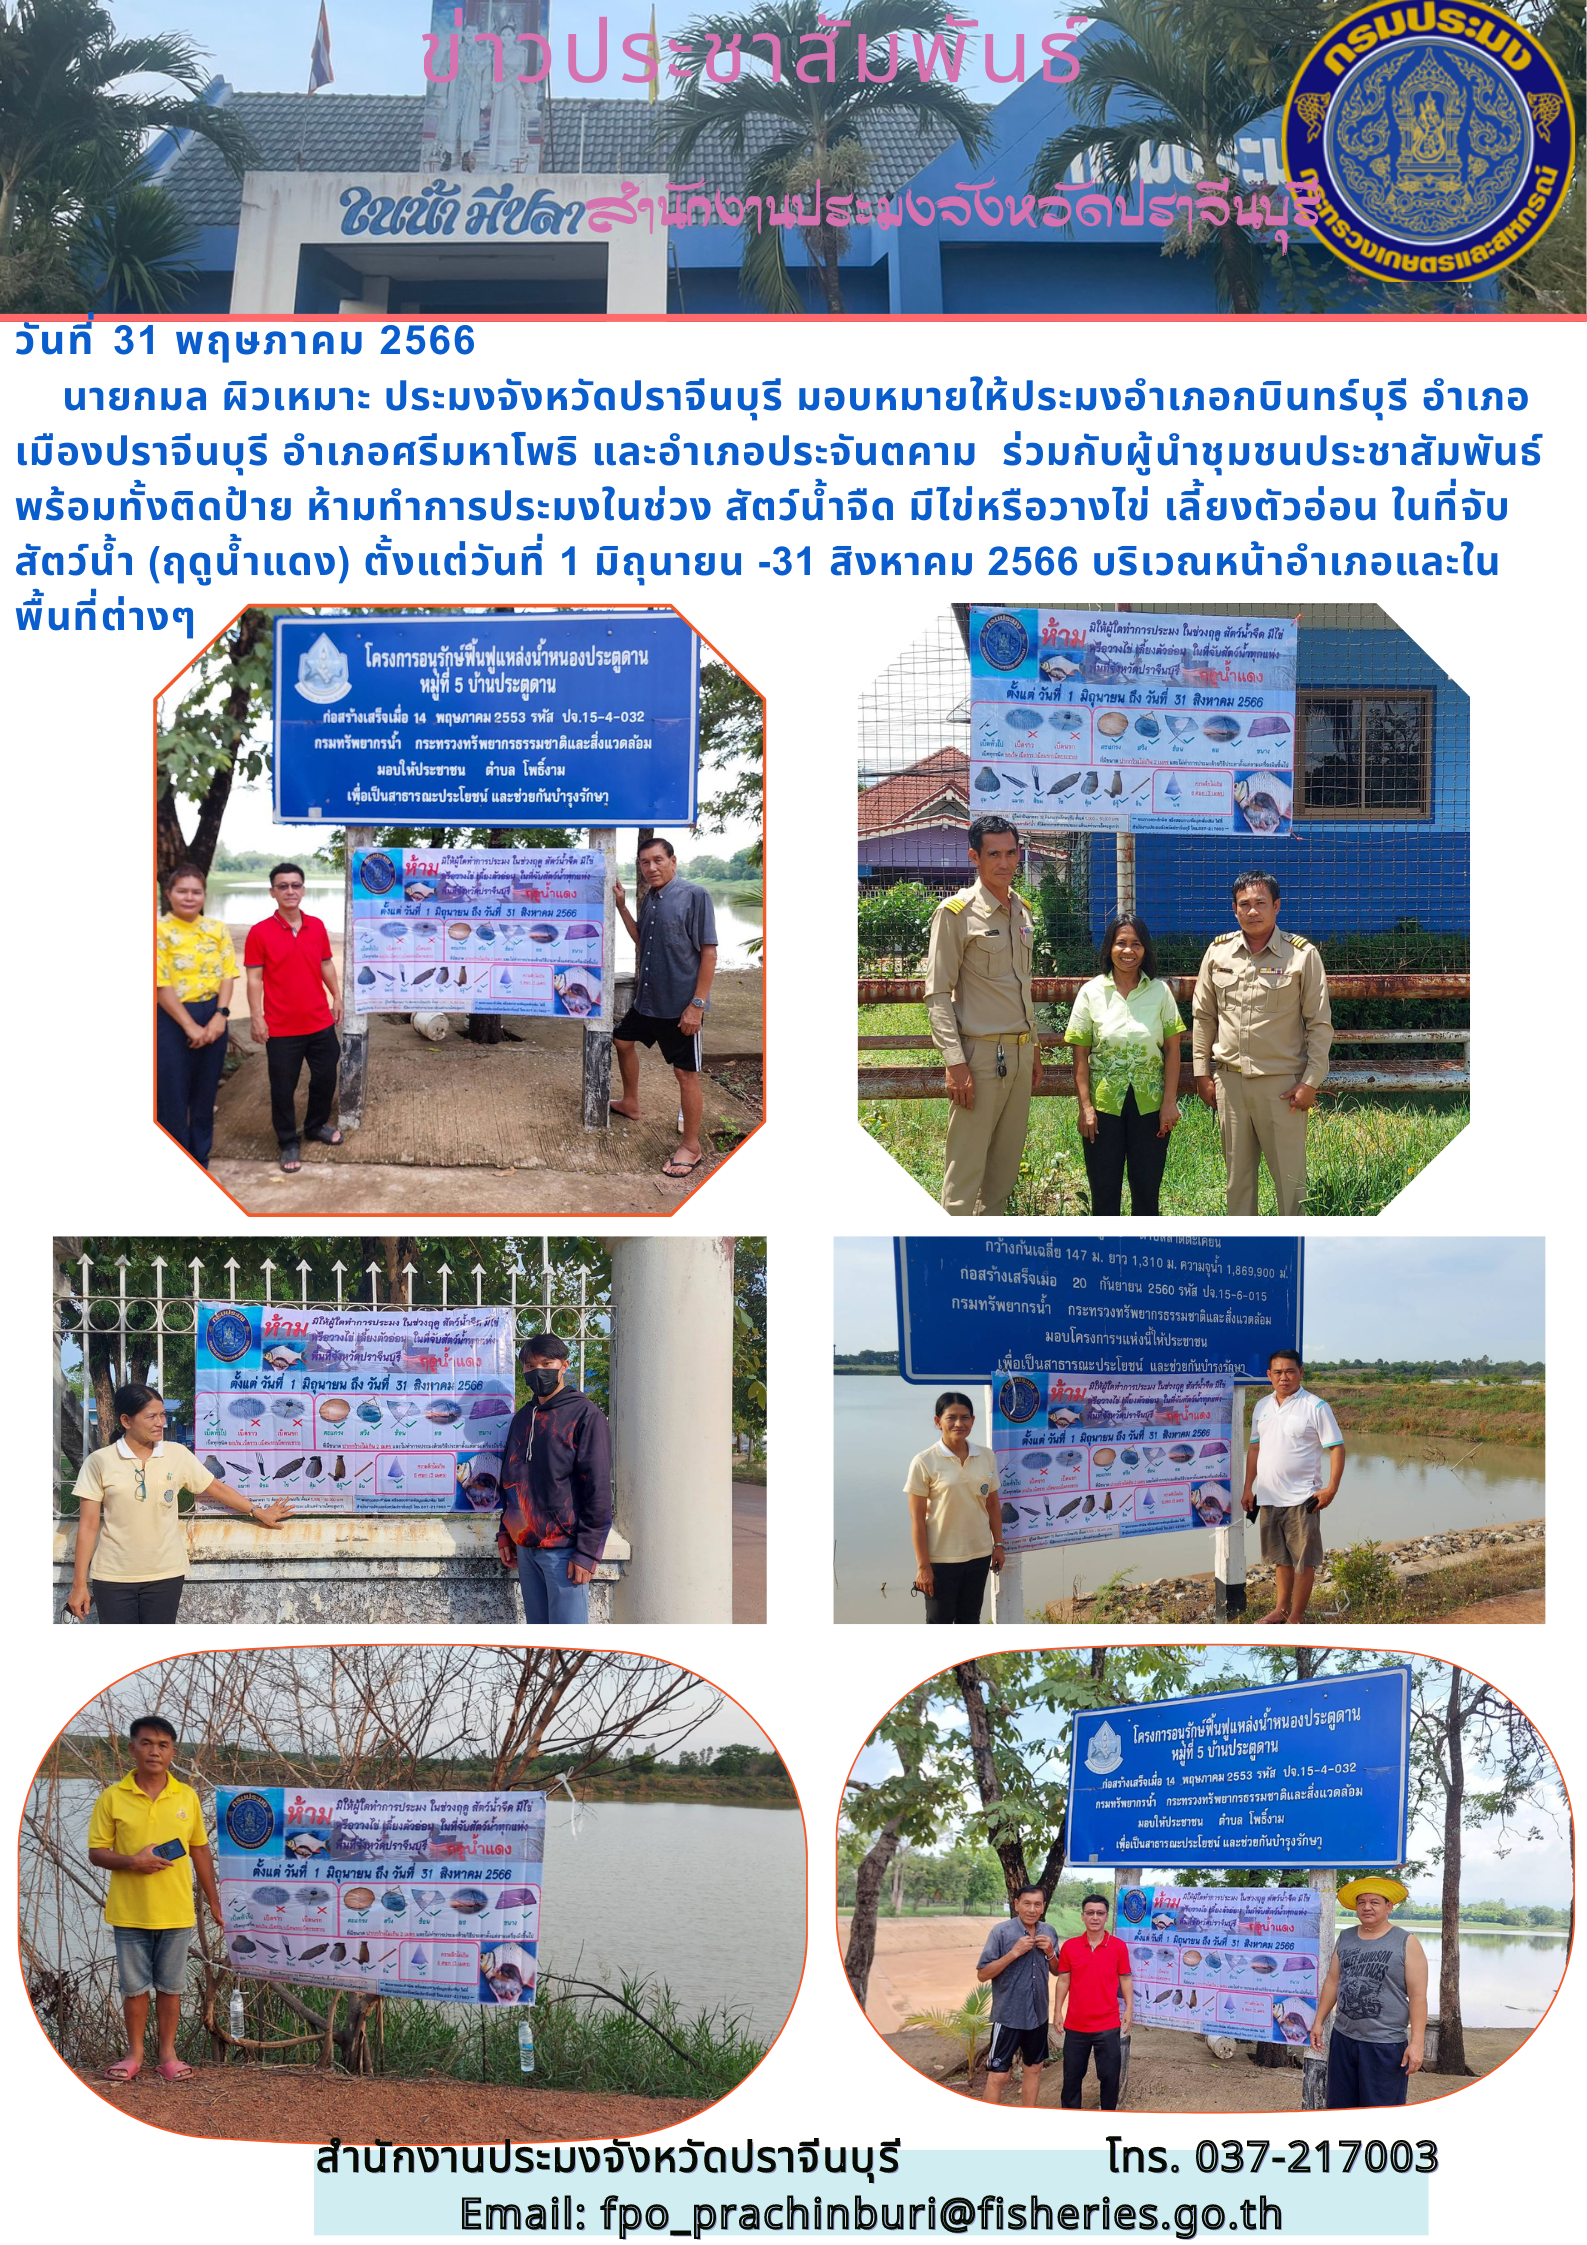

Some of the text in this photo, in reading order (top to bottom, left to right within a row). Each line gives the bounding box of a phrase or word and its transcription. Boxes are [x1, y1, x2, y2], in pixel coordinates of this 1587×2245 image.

[340, 178, 587, 236] ในน้ำ มีปลา
[364, 637, 649, 674] โครงการอนุรักษ์ฟื้นฟูแหล่งน้ำหนองประตูดาน
[420, 668, 557, 701] หมู่ที่ 5 บ้านประตูดาน
[323, 703, 645, 727] ก่อสร้างเสร็จเมื่อ 14 พฤษภาคม 2553 รหัส ปจ.15-4-032
[314, 730, 653, 750] กรมทรัพยากรน้ำ กระทรวงทรัพยากรธรรมชาติและสิ่งแวดล้อม
[377, 757, 566, 777] มอบให้ประชาชน ตำบล โพธิ์งาม
[347, 783, 610, 808] เพื่อเป็นสาธารณะประโยชน์ และช่วยกันบำรุงรักษา
[1066, 1248, 1088, 1261] 147
[1092, 1252, 1104, 1264] ม.
[1108, 1253, 1128, 1265] ยาว
[1132, 1255, 1164, 1269] 1,310
[1166, 1258, 1177, 1270] ม.
[1180, 1255, 1223, 1277] ความจุน้ำ
[1226, 1264, 1275, 1279] 1,869,900
[1072, 1277, 1087, 1288] 20
[1099, 1276, 1143, 1293] กันยายน
[1148, 1283, 1175, 1295] 2560
[1178, 1282, 1198, 1297] รหัส
[1203, 1284, 1267, 1302] ปจ.15-6-015
[951, 1293, 1272, 1326] กรมทรัพยากรน้ำ กระทรวงทรัพยากรธรรมชาติและสิ่งแวดล้อม
[998, 1349, 1144, 1373] เพื่อเป็นสาธารณะประโยชน์
[1132, 1706, 1361, 1744] โครงการอนุรักษ์ฟื้นฟูแหล่งน้ำหนองประตูดาน
[1172, 1738, 1279, 1767] หมู่ที่ 5 บ้านประตูดาน
[1102, 1762, 1357, 1789] ก่อสร้างเสร็จเมื่อ 14 พฤษภาคม 2553 รหัส ปจ.15-4-032
[1095, 1783, 1363, 1809] กรมทรัพยากรน้ำ กระทรวงทรัพยากรธรรมชาติและสิ่งแวดล้อม
[1137, 1808, 1285, 1829] มอบให้ประชาชน ตำบล โพธิ์งาม
[1116, 1833, 1323, 1852] เพื่อเป็นสาธารณะประโยชน์ และช่วยกันบำรุงรักษา
